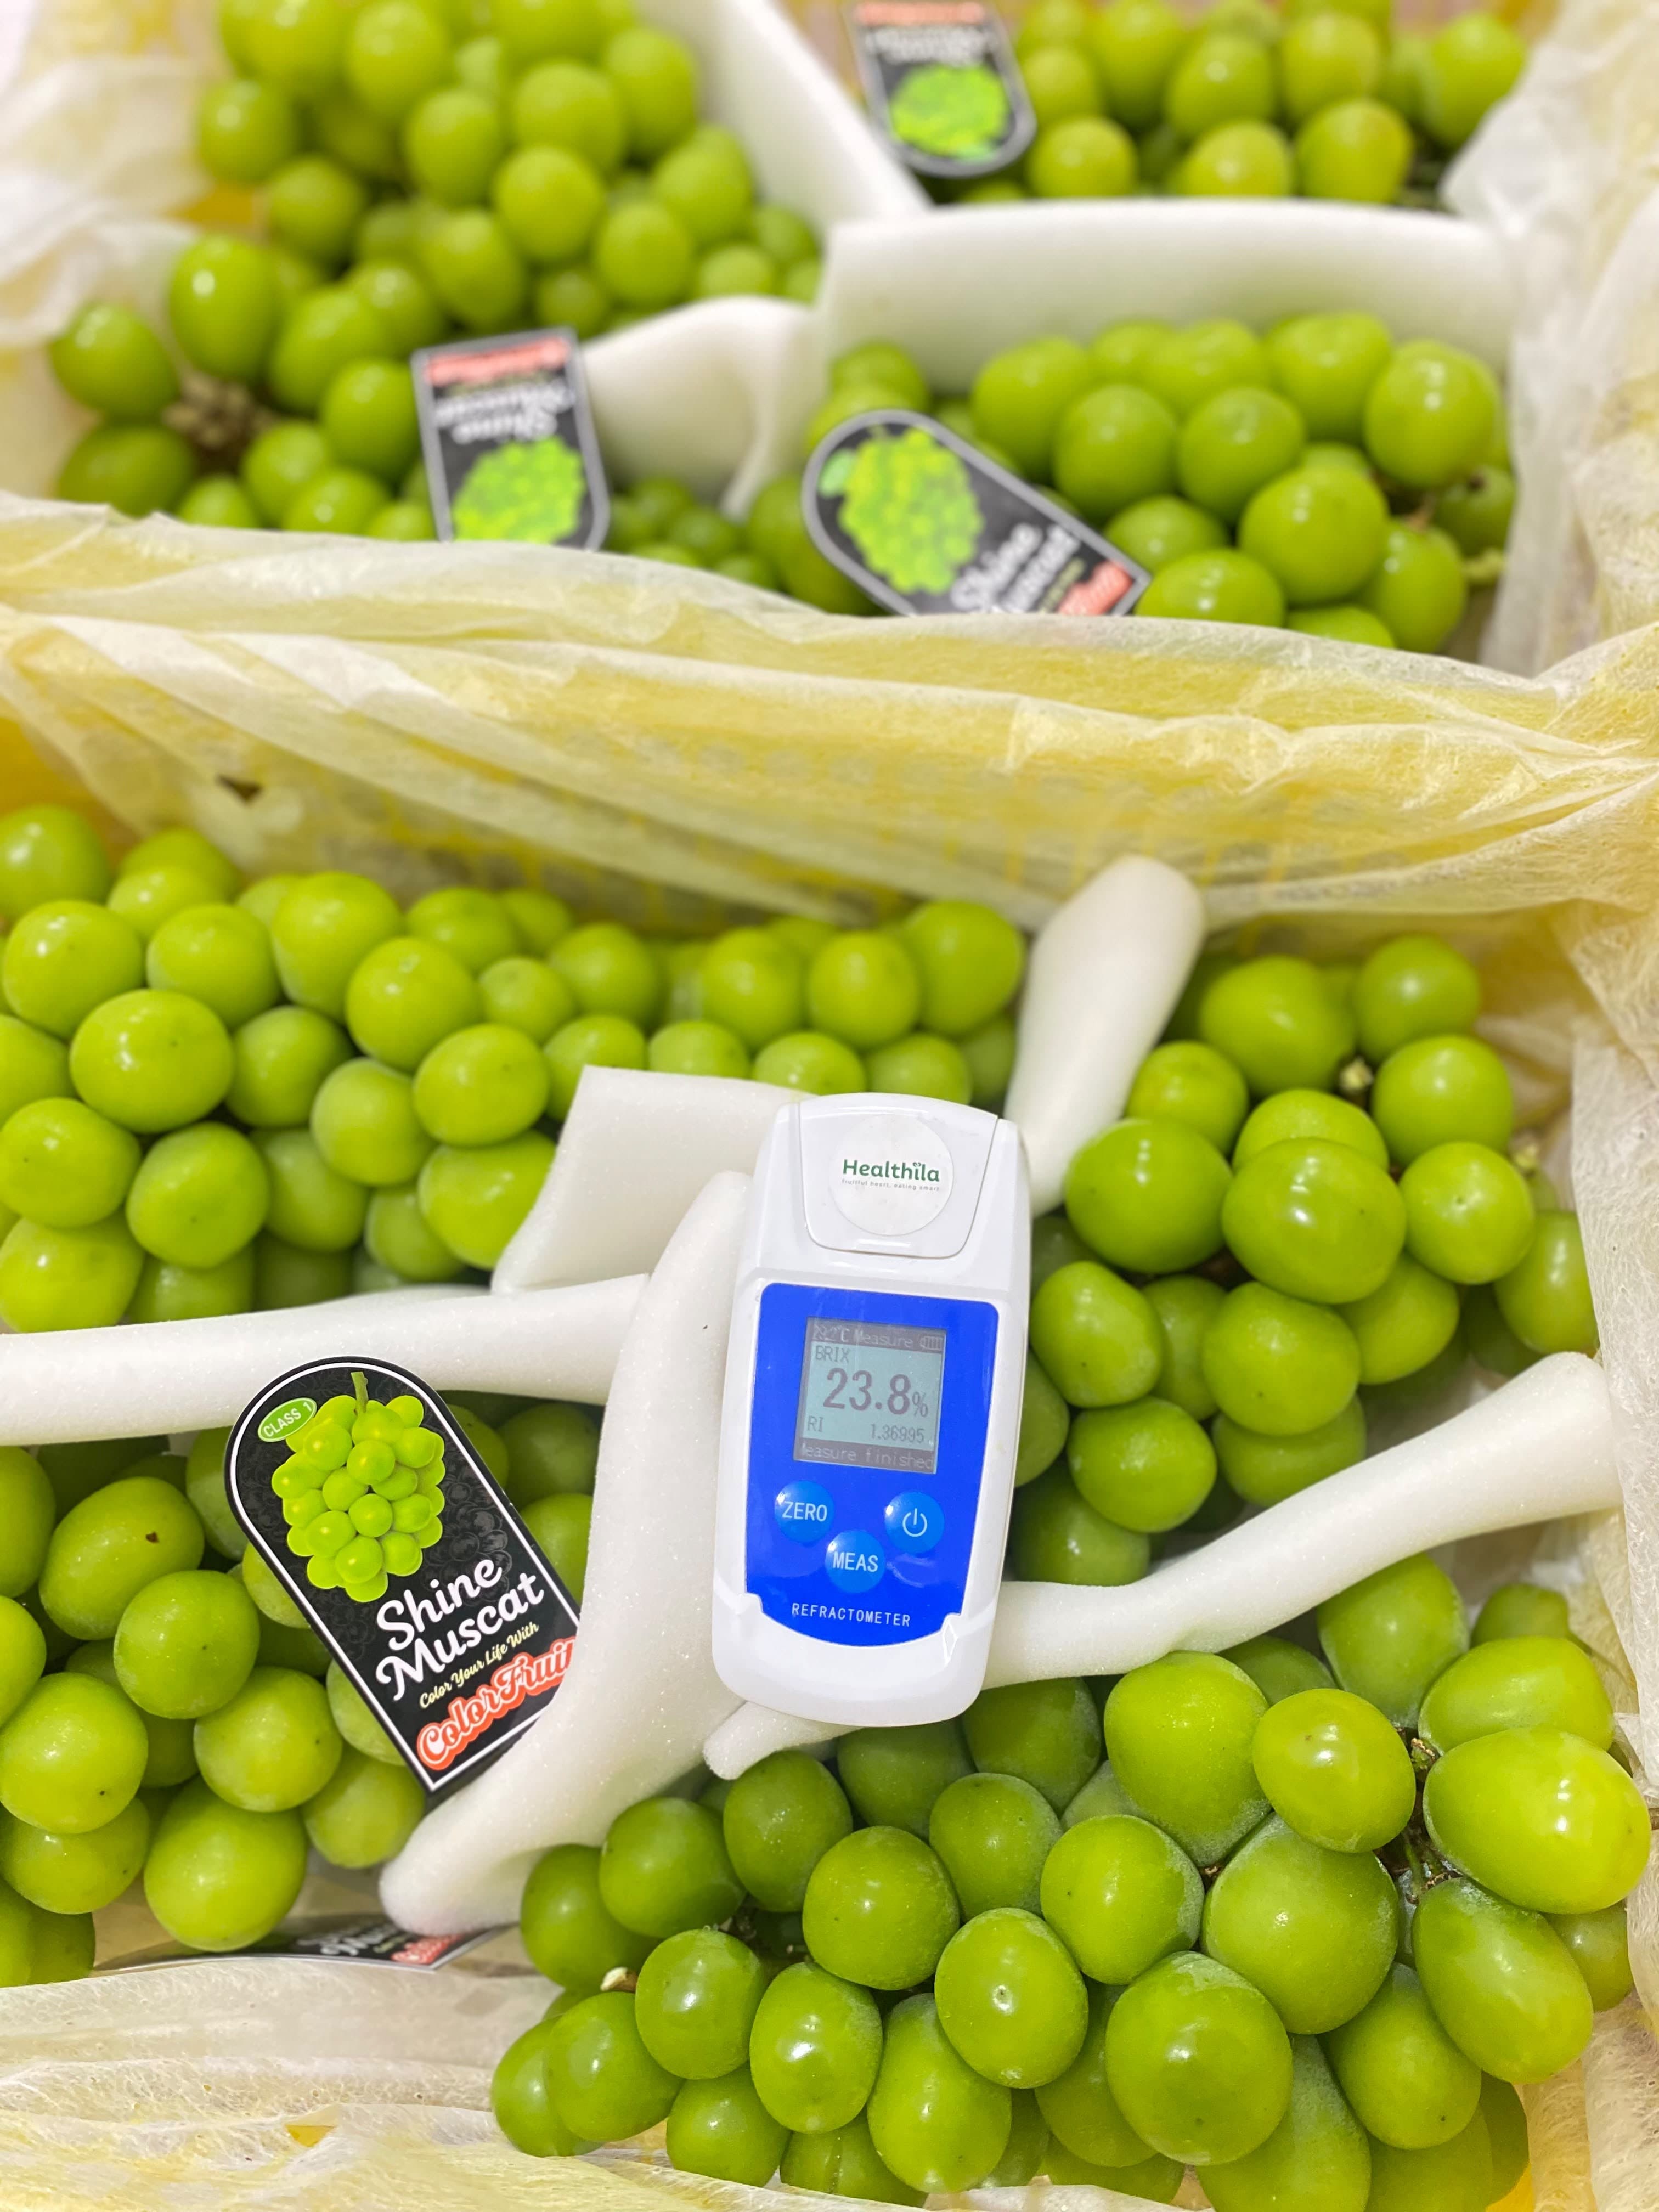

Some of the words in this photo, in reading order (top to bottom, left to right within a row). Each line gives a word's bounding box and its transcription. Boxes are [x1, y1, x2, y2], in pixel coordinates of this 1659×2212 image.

[854, 1328, 913, 1348] Measure
[815, 1345, 850, 1363] BRIX
[263, 1408, 301, 1437] CLASS
[303, 1402, 312, 1412] 1
[807, 1415, 823, 1432] RI
[870, 1424, 925, 1443] 1.36995
[866, 1448, 933, 1469] finished
[782, 1502, 828, 1522] ZERO
[832, 1551, 879, 1572] MEAS
[376, 1559, 503, 1650] Shine
[792, 1602, 911, 1627] REFRACTOMETER
[375, 1572, 544, 1701] Muscat
[419, 1681, 452, 1708] Color
[451, 1660, 484, 1688] Your
[485, 1644, 507, 1665] Life
[506, 1621, 539, 1648] With
